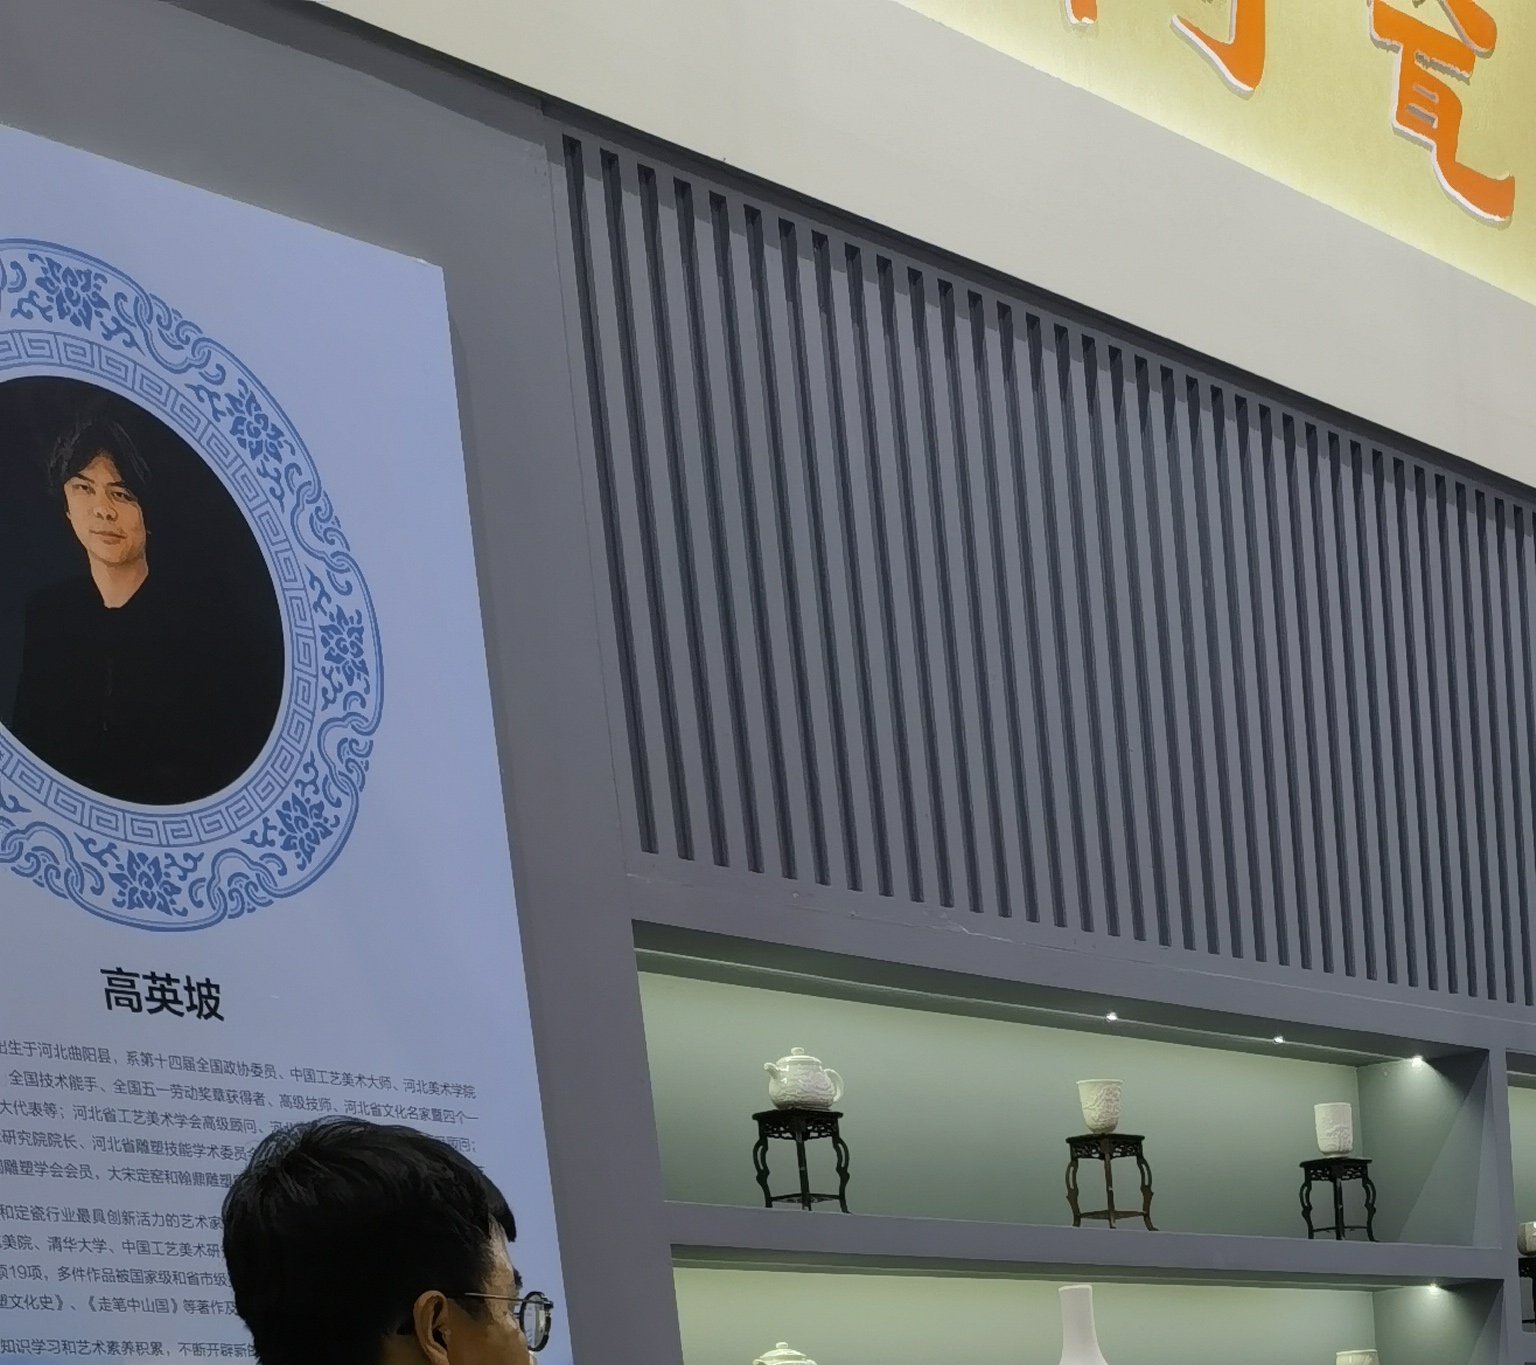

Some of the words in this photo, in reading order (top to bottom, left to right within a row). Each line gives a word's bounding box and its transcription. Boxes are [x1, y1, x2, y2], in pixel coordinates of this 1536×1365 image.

[100, 966, 224, 1021] 高英坡
[0, 1234, 225, 1259] 美院、清华大学、中国工艺美术研
